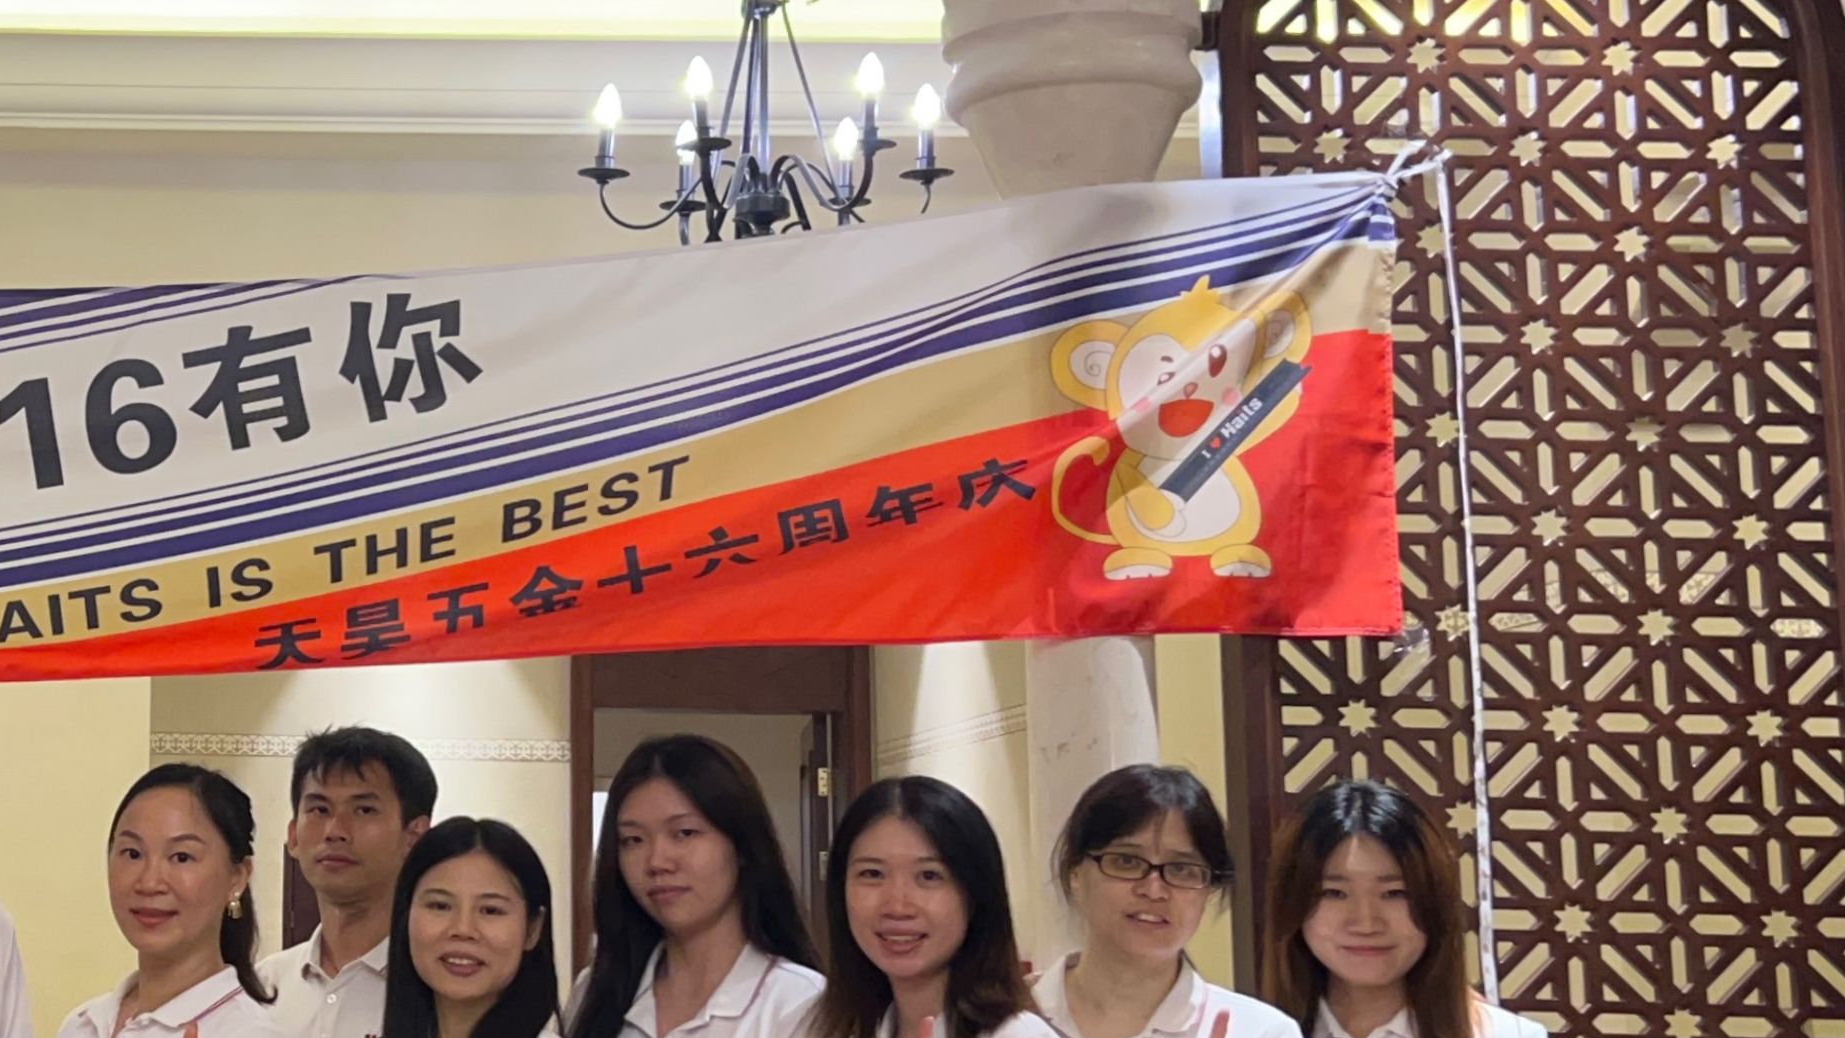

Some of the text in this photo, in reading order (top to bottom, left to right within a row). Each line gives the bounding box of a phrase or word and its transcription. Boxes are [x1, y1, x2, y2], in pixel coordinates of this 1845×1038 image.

[206, 558, 274, 609] IS
[312, 516, 457, 584] THE
[500, 454, 691, 544] BEST
[254, 456, 1038, 670] 天昊五金十六周年庆
